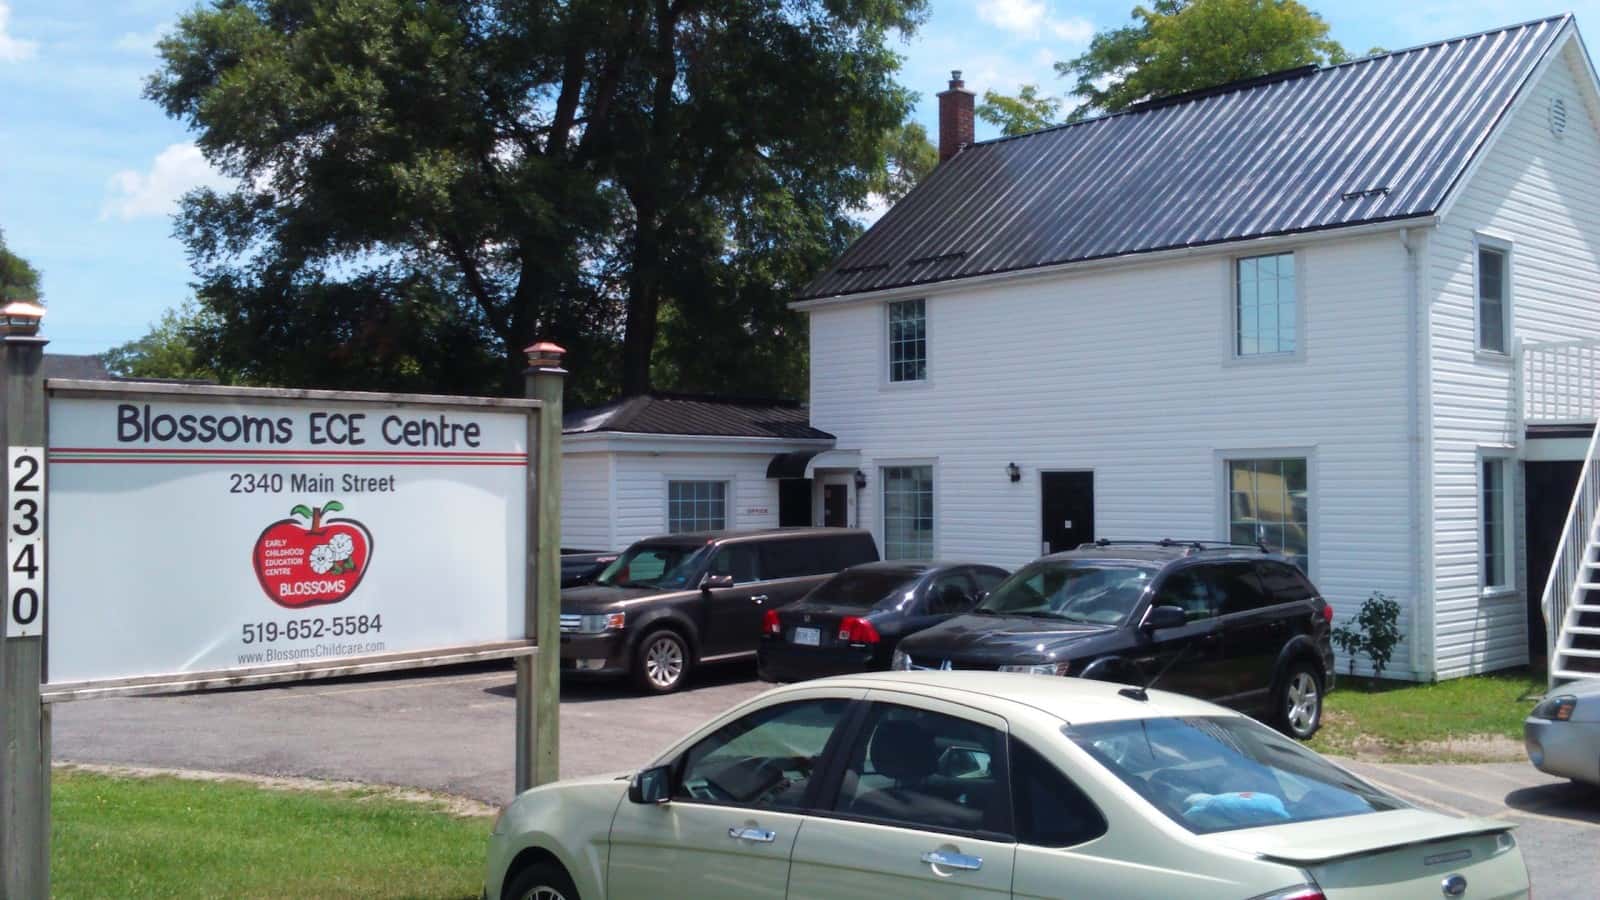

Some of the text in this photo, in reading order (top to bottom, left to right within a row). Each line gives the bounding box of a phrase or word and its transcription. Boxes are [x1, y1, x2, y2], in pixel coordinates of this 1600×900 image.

[117, 404, 481, 448] Blossoms ECE Centre
[229, 473, 395, 494] 2340 Main Street
[12, 455, 40, 624] 2340
[265, 539, 287, 548] EARLY
[265, 548, 304, 557] CHILDHOOD
[265, 558, 303, 567] EDUCATION
[265, 568, 291, 576] CENTRE
[280, 579, 346, 596] BLOSSOMS
[242, 614, 383, 644] 519-652-5584
[238, 641, 385, 664] www.BlossomsChildcare.com
